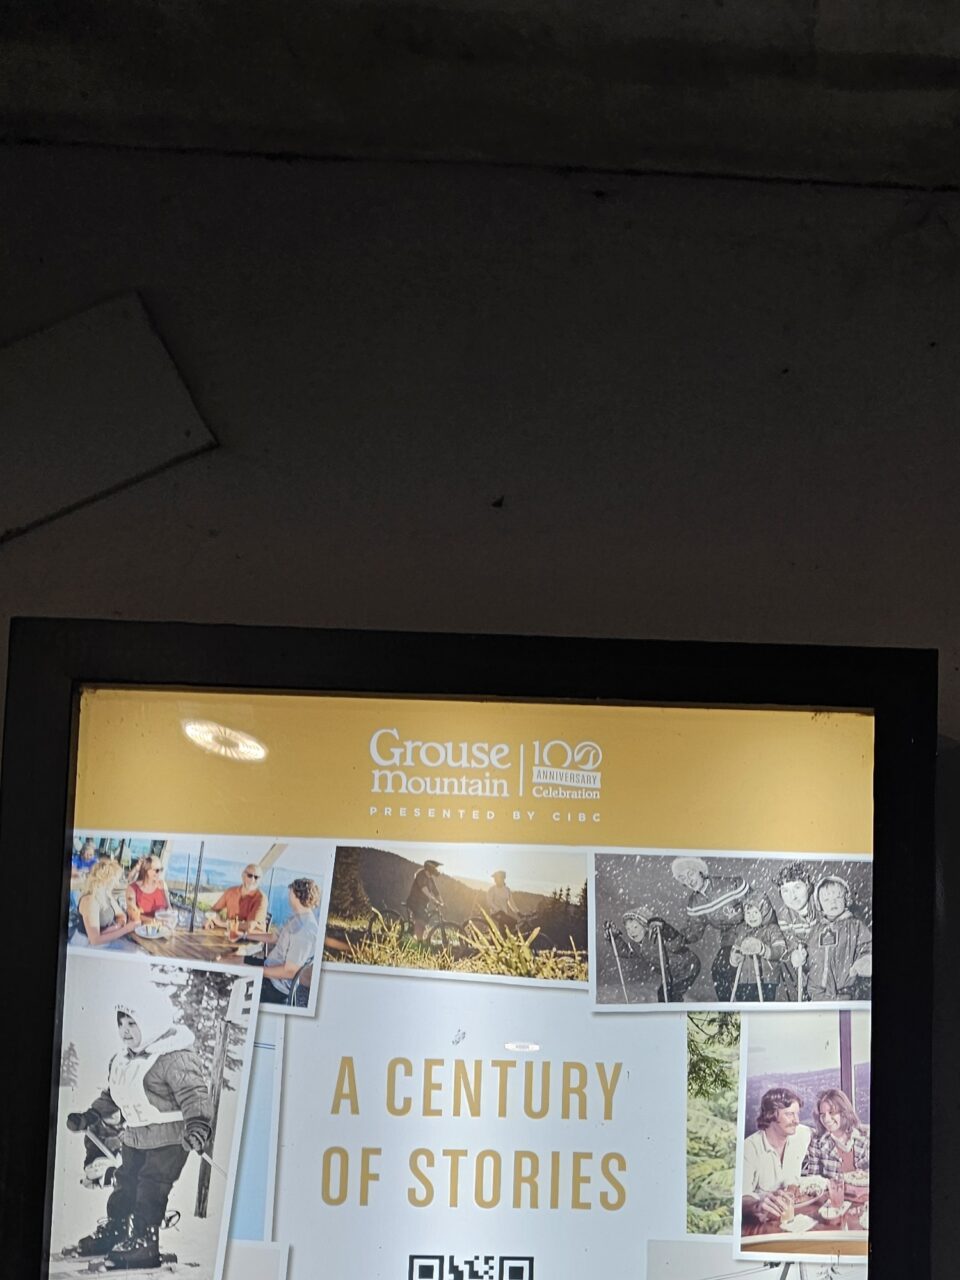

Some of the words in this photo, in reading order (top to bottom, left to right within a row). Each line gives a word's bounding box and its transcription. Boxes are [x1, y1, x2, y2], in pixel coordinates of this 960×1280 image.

[370, 728, 511, 769] Grouse
[532, 740, 602, 770] 100
[532, 786, 600, 799] Celebration
[536, 770, 598, 785] ANNIVERSARY
[370, 806, 495, 820] PRESENTED
[513, 811, 535, 821] BY
[552, 812, 601, 822] CIBC
[331, 1056, 360, 1115] A
[385, 1057, 623, 1121] CENTURY
[320, 1146, 382, 1207] OF
[407, 1147, 627, 1211] STORIES
